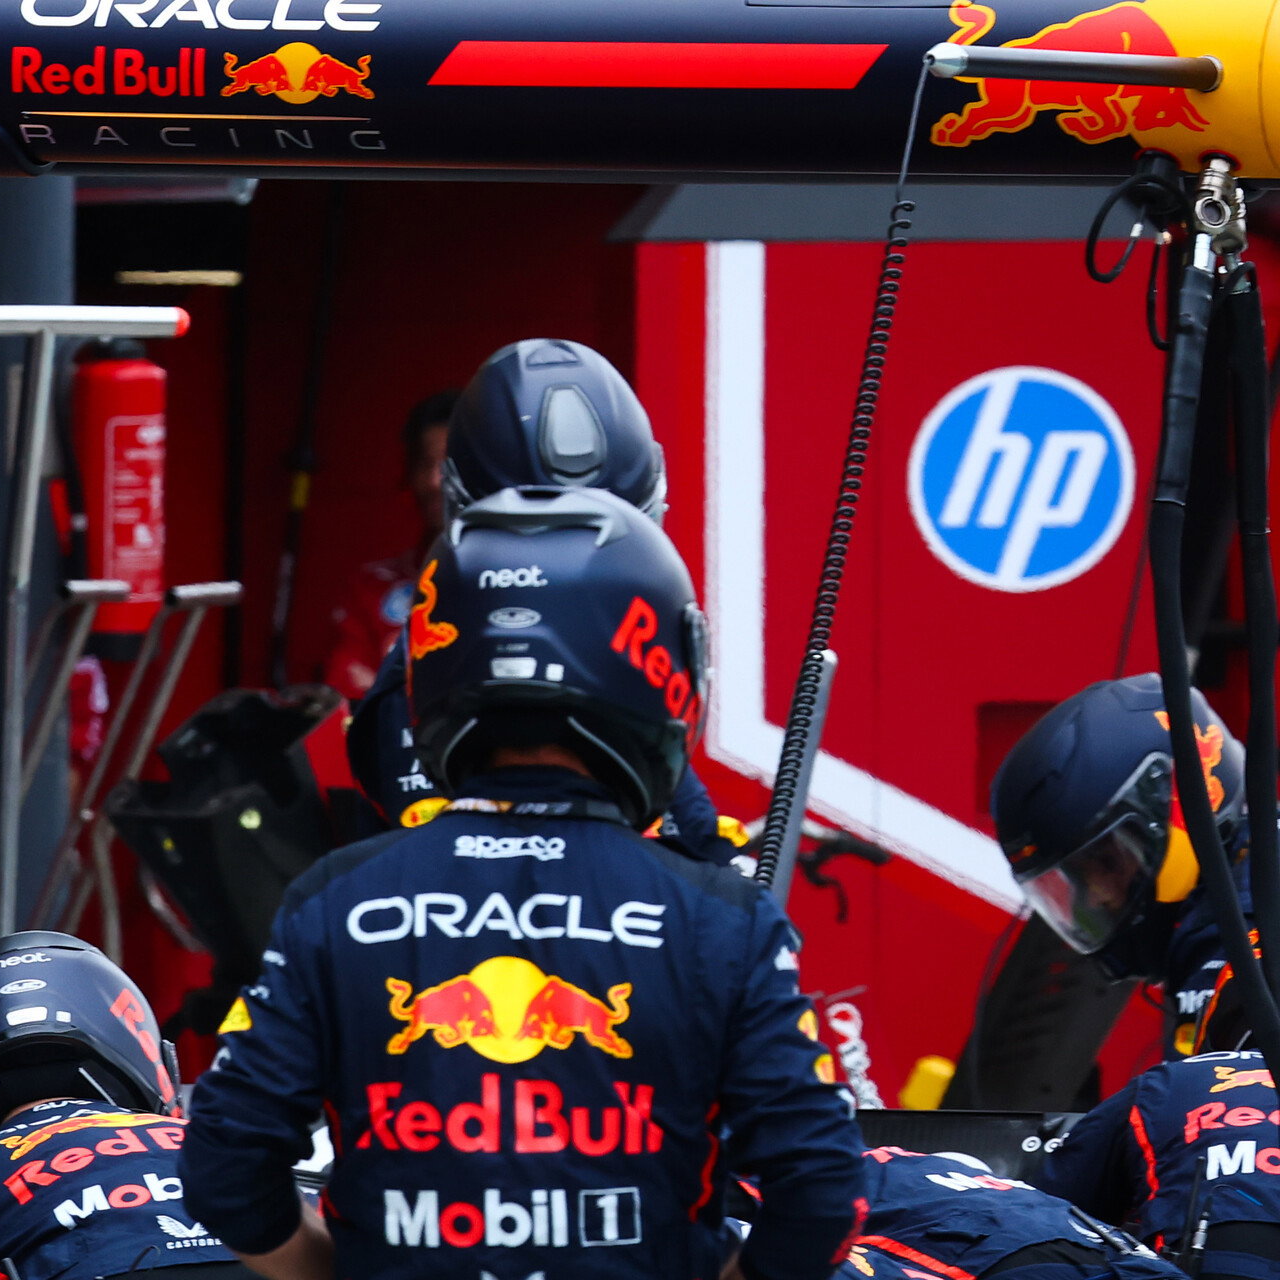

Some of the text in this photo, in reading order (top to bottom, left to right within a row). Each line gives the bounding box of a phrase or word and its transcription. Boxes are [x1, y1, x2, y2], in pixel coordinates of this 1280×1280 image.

[11, 46, 206, 97] Red Bull
[19, 124, 386, 150] RACING
[940, 375, 1107, 582] hp
[479, 565, 548, 588] neat.
[346, 892, 666, 949] ORACLE
[3, 1128, 150, 1206] Red
[53, 1172, 184, 1231] Mob
[384, 1188, 569, 1248] Mobil
